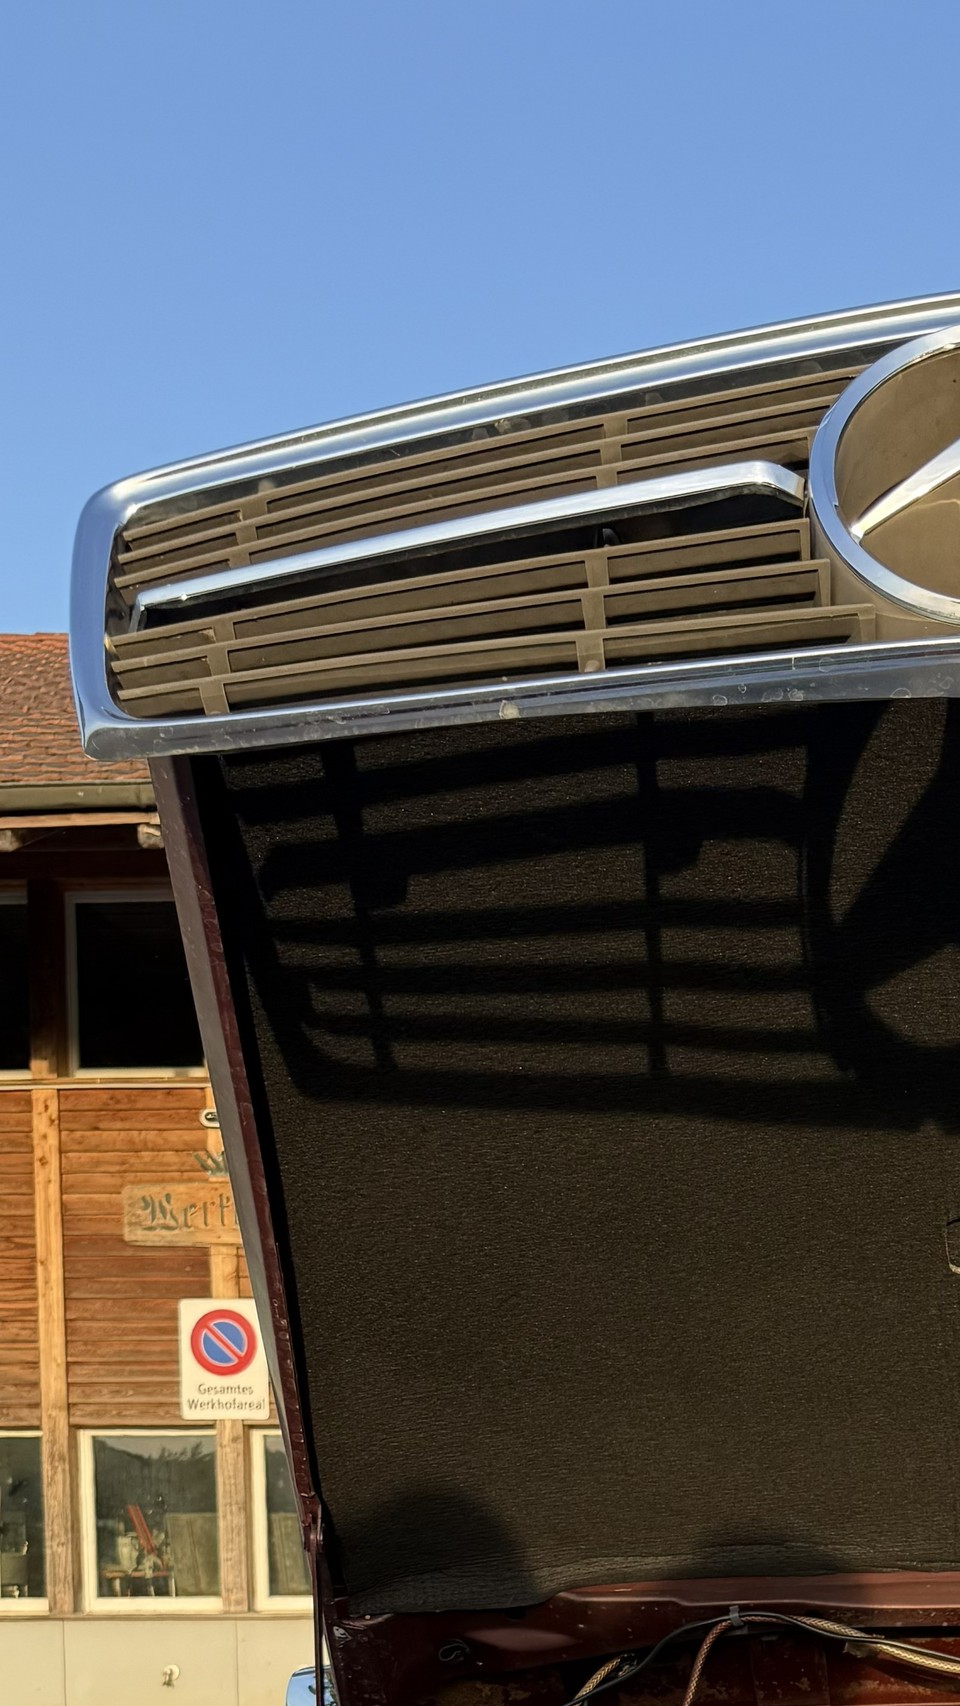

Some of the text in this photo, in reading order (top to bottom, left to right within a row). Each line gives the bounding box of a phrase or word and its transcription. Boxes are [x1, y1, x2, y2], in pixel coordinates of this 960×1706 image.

[139, 1193, 238, 1231] Werk
[198, 1383, 254, 1395] Gesamtes
[187, 1398, 266, 1411] Werkhofareal
